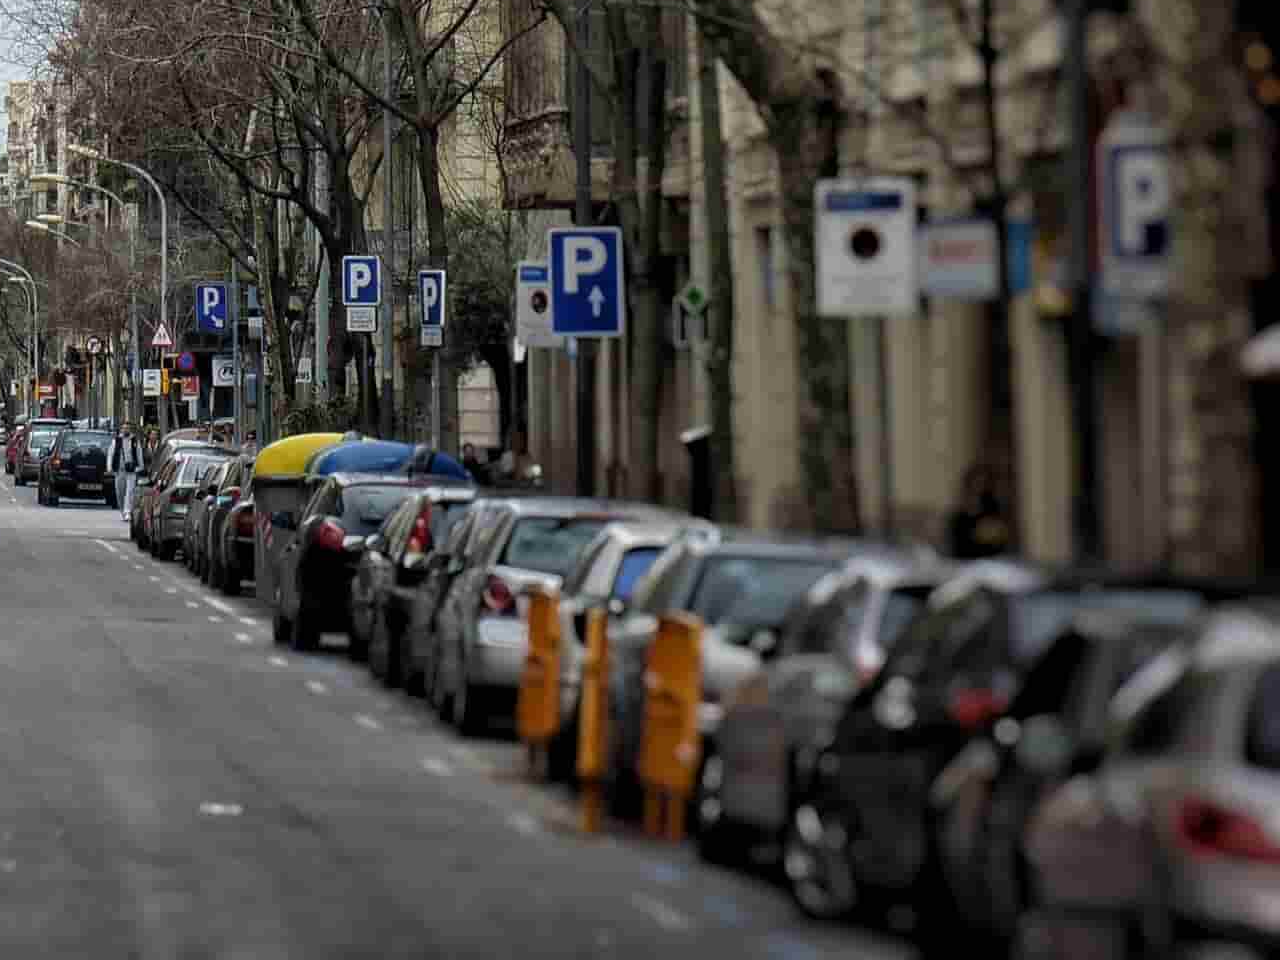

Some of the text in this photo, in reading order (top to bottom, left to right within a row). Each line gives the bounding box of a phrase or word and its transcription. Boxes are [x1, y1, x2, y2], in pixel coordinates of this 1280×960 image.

[1120, 152, 1169, 250] P
[351, 263, 371, 298] P
[563, 237, 608, 294] P
[203, 287, 219, 315] P
[423, 278, 437, 321] P
